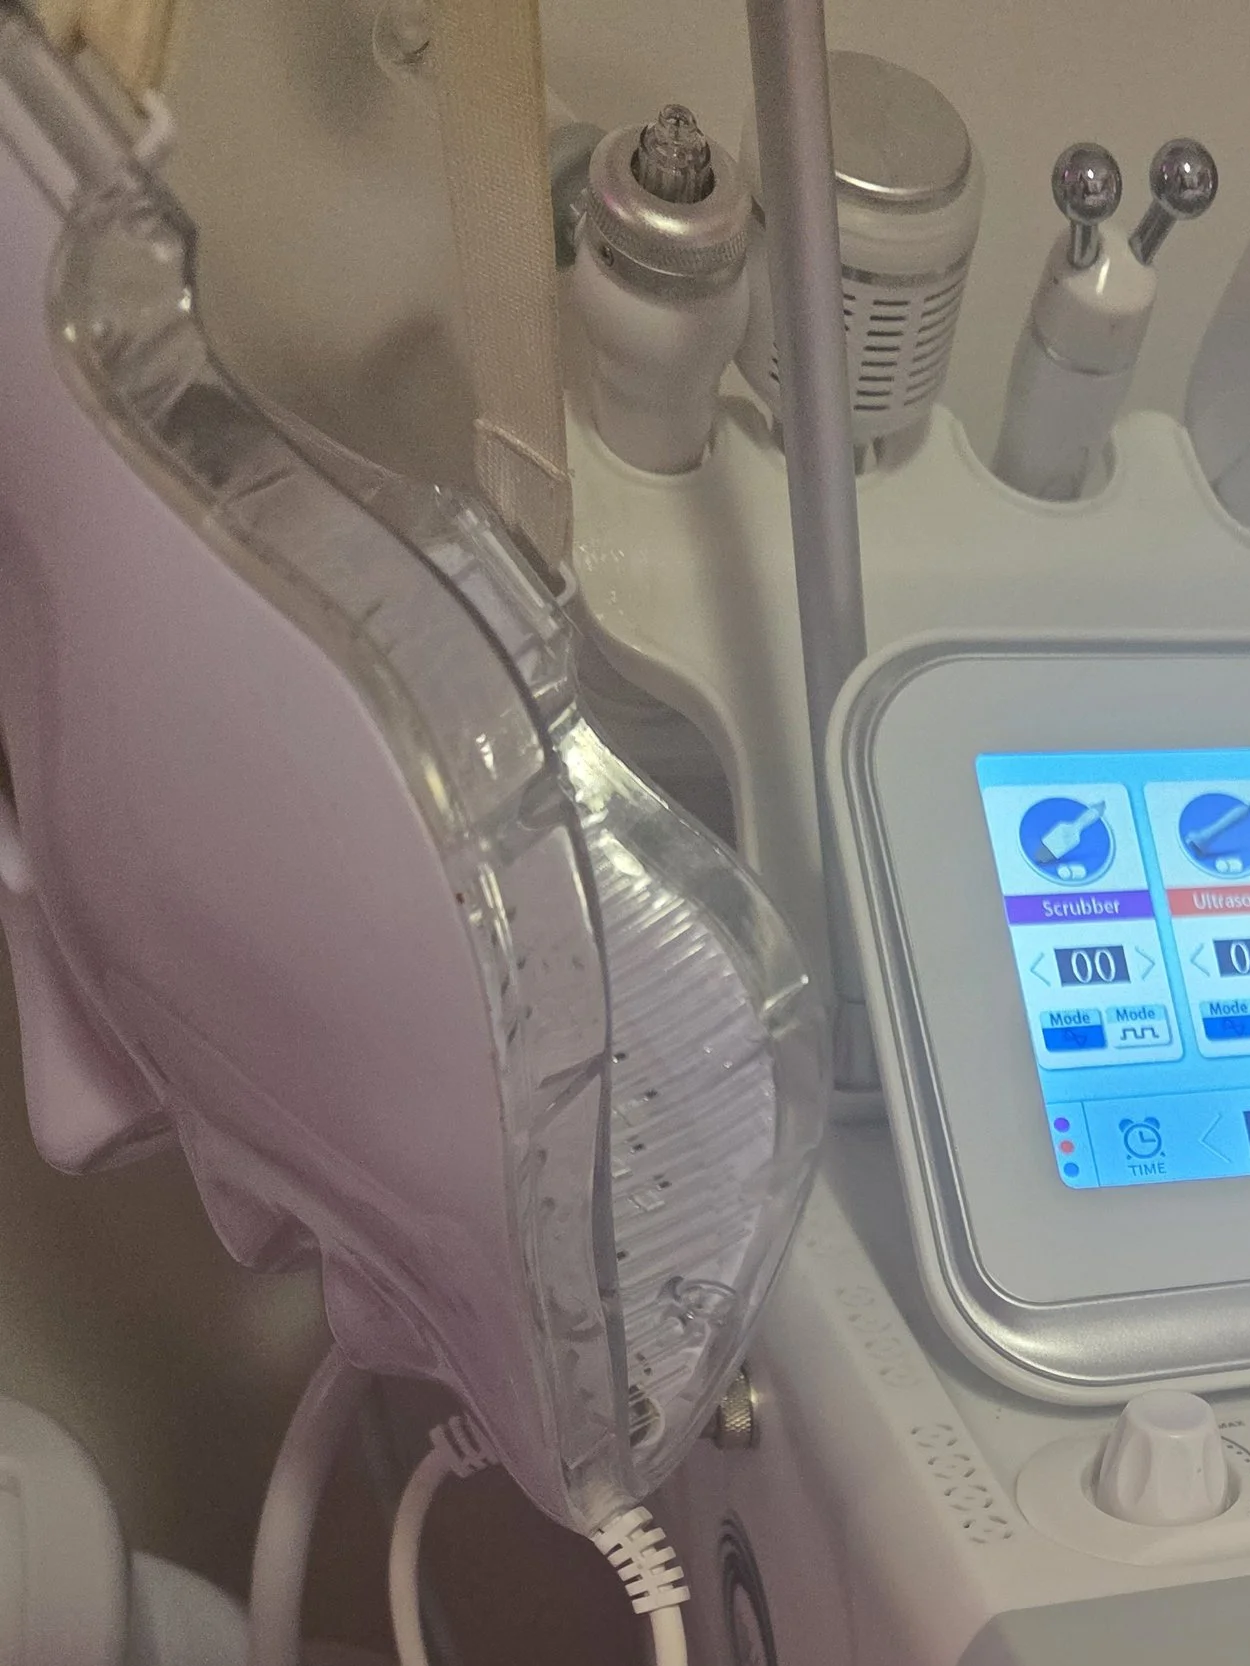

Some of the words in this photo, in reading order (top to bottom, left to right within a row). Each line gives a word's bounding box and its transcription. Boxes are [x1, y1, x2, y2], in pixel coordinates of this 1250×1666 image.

[1043, 900, 1121, 918] Scrubber
[1071, 949, 1116, 984] 00
[1116, 1006, 1156, 1022] Mode
[1209, 1000, 1248, 1016] Mode
[1050, 1010, 1091, 1027] Mode
[1128, 1163, 1167, 1177] TIME
[1218, 1420, 1245, 1430] MAX
